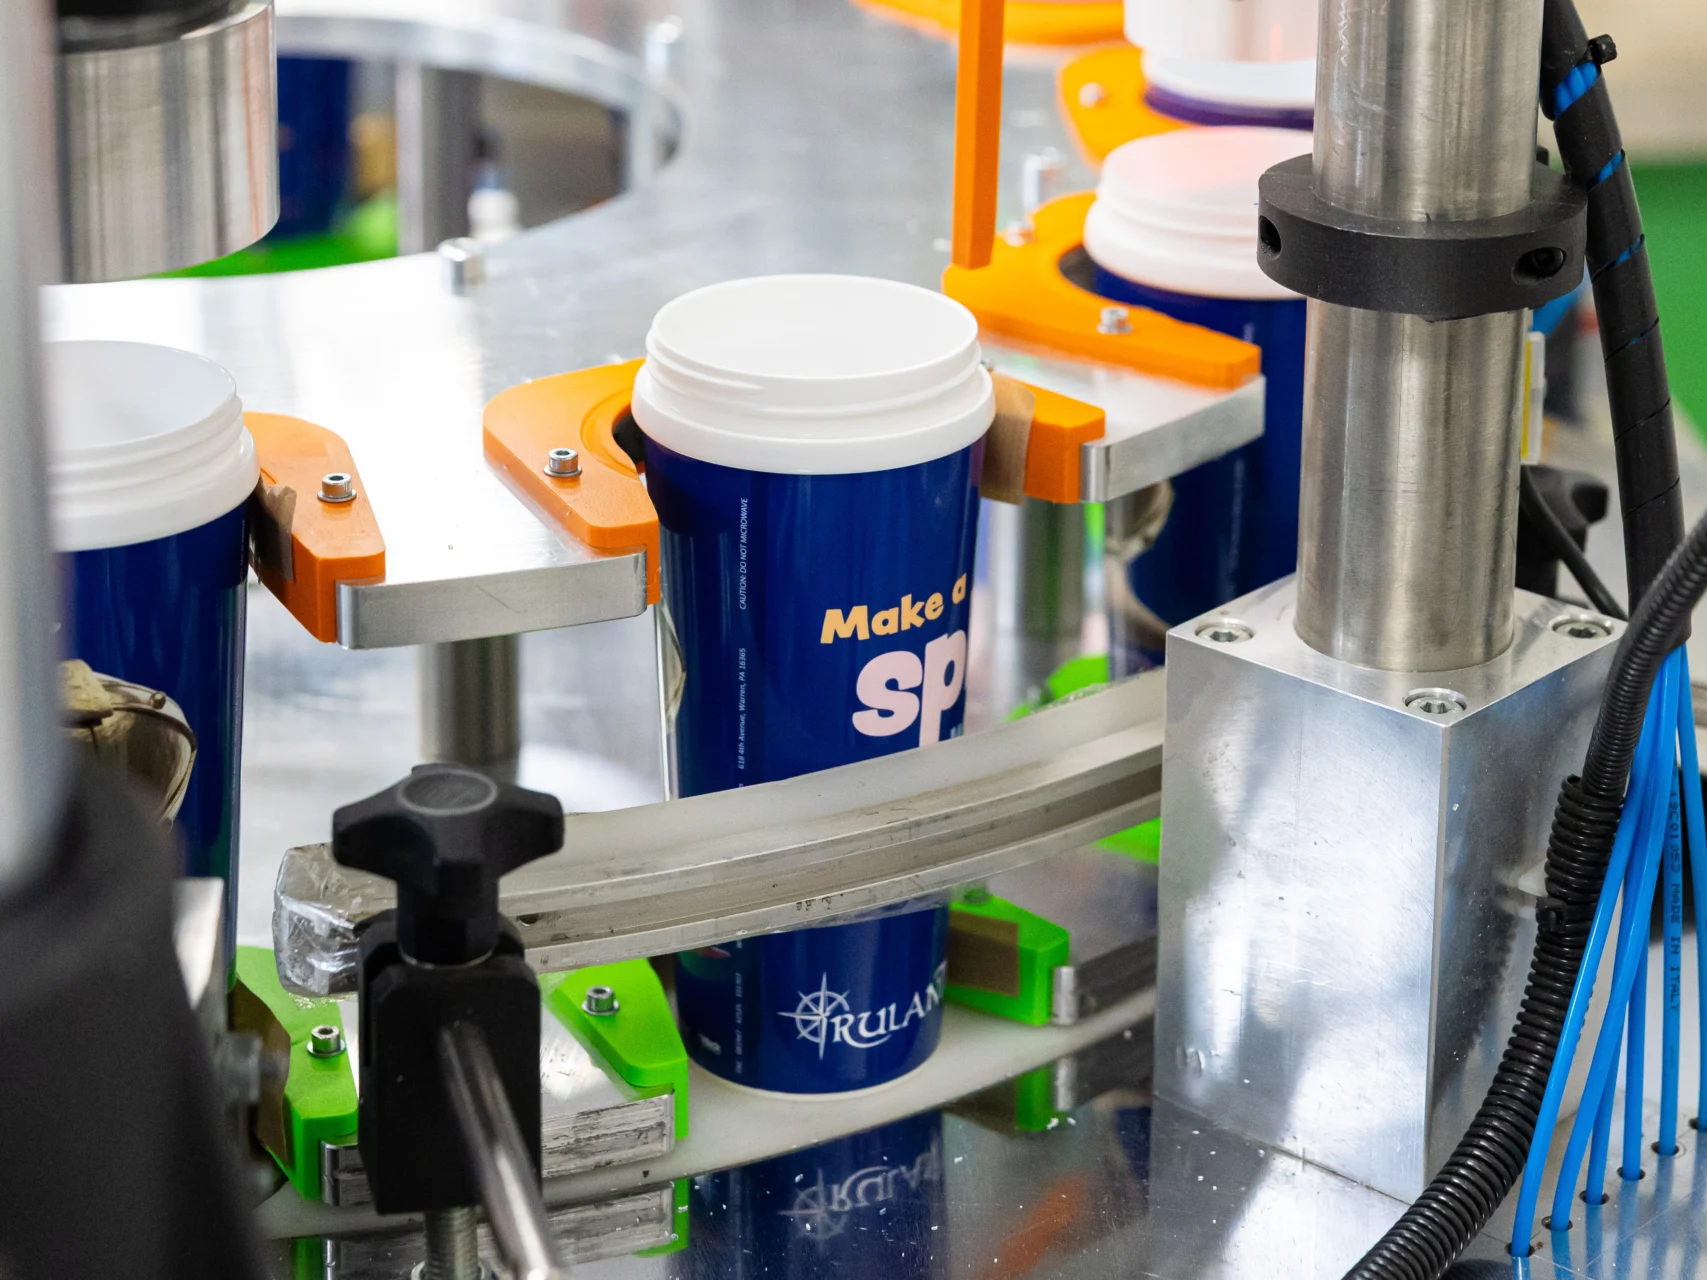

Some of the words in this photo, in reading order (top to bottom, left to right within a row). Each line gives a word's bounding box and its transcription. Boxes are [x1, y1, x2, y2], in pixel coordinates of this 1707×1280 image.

[740, 498, 748, 543] MICROWAVE
[740, 544, 748, 560] NOT
[740, 561, 747, 573] DO
[739, 574, 747, 610] CAUTION:
[820, 592, 944, 644] Make
[952, 572, 967, 604] a
[738, 671, 746, 682] PA
[738, 683, 747, 711] Warren,
[738, 713, 746, 742] Avenue,
[737, 755, 745, 770] 618
[1671, 884, 1680, 923] MADE
[1671, 936, 1680, 955] IN
[1670, 966, 1680, 1010] ITALY
